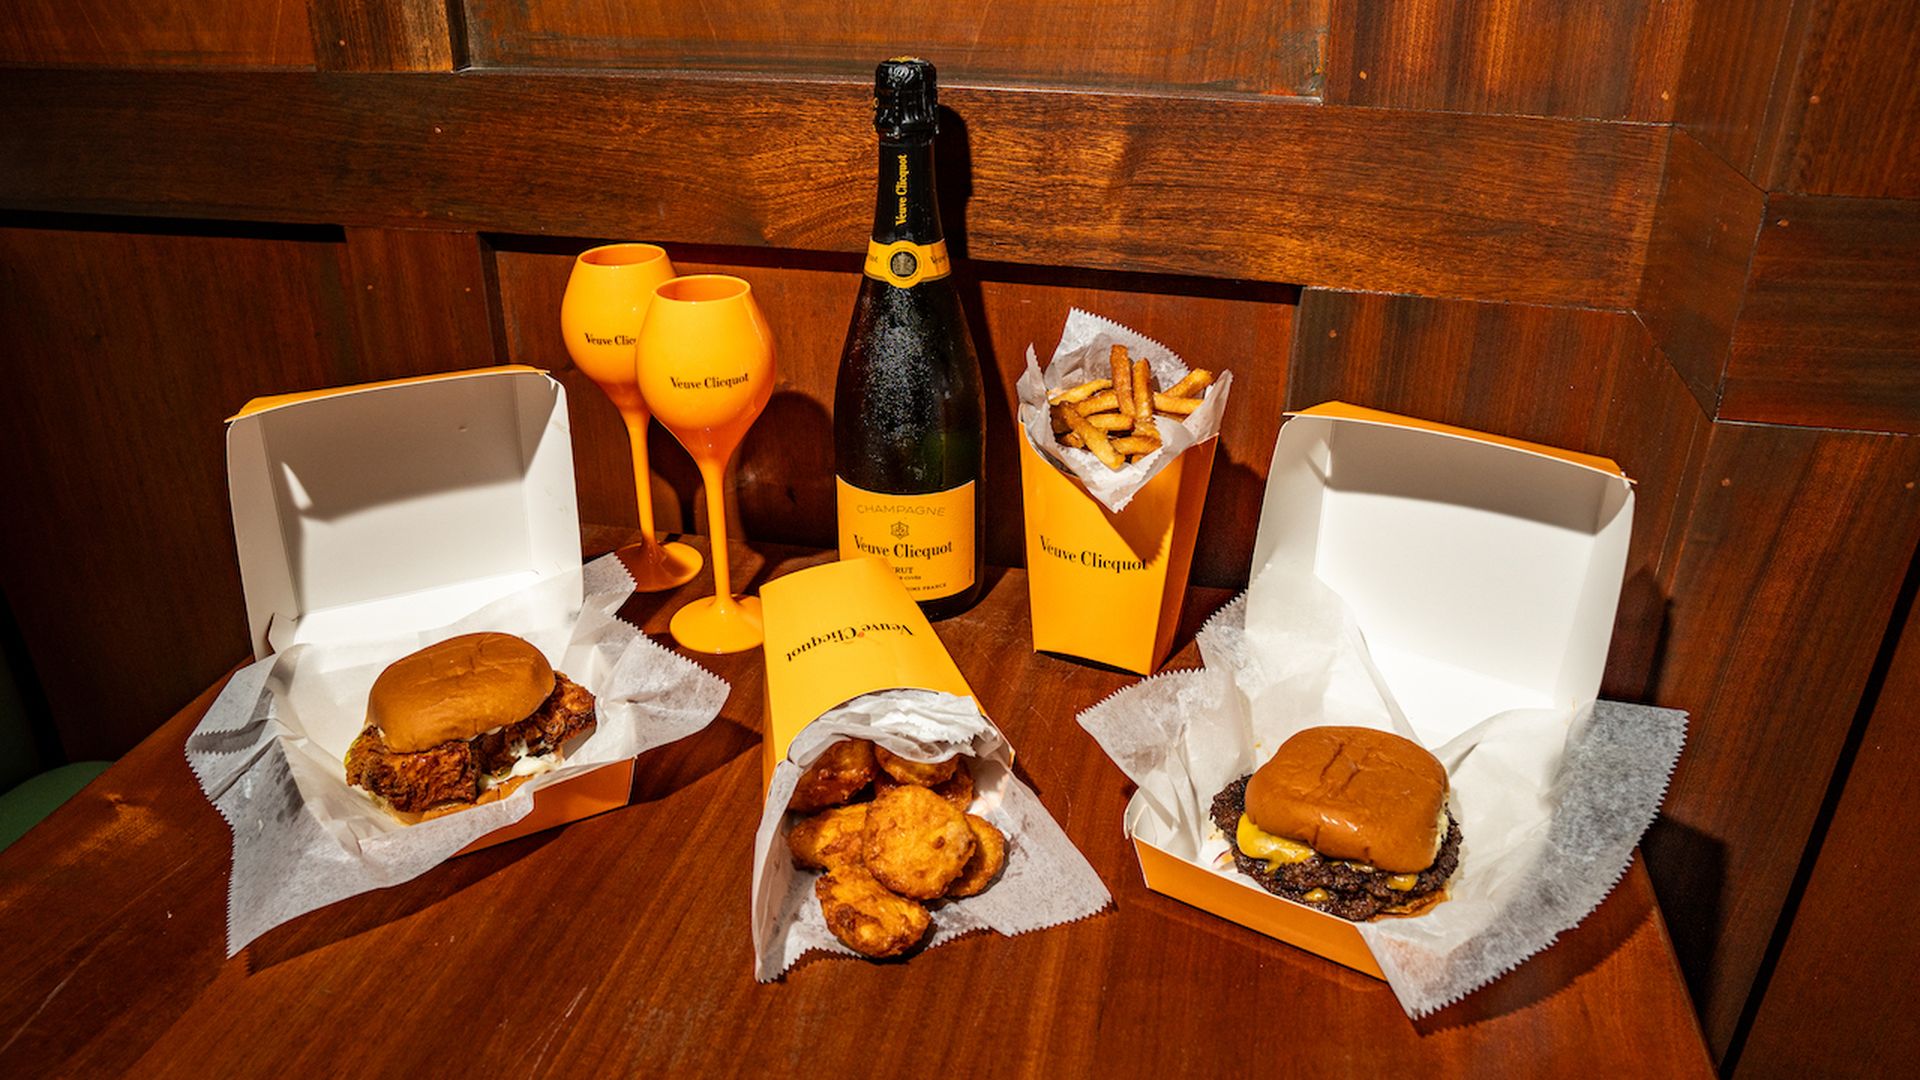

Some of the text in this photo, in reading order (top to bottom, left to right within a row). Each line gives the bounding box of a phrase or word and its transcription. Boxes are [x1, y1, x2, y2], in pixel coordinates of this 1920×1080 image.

[895, 154, 910, 226] Veuve Clicquot
[584, 332, 637, 346] Veuve Clic
[670, 373, 749, 390] Veuve Clicquot
[856, 504, 946, 517] CHAMPAGNE
[854, 534, 952, 560] Veuve Clicquot
[1040, 534, 1146, 574] Veuve Clicquot
[892, 566, 914, 575] RUT
[786, 623, 914, 662] Veuve Clicquot
